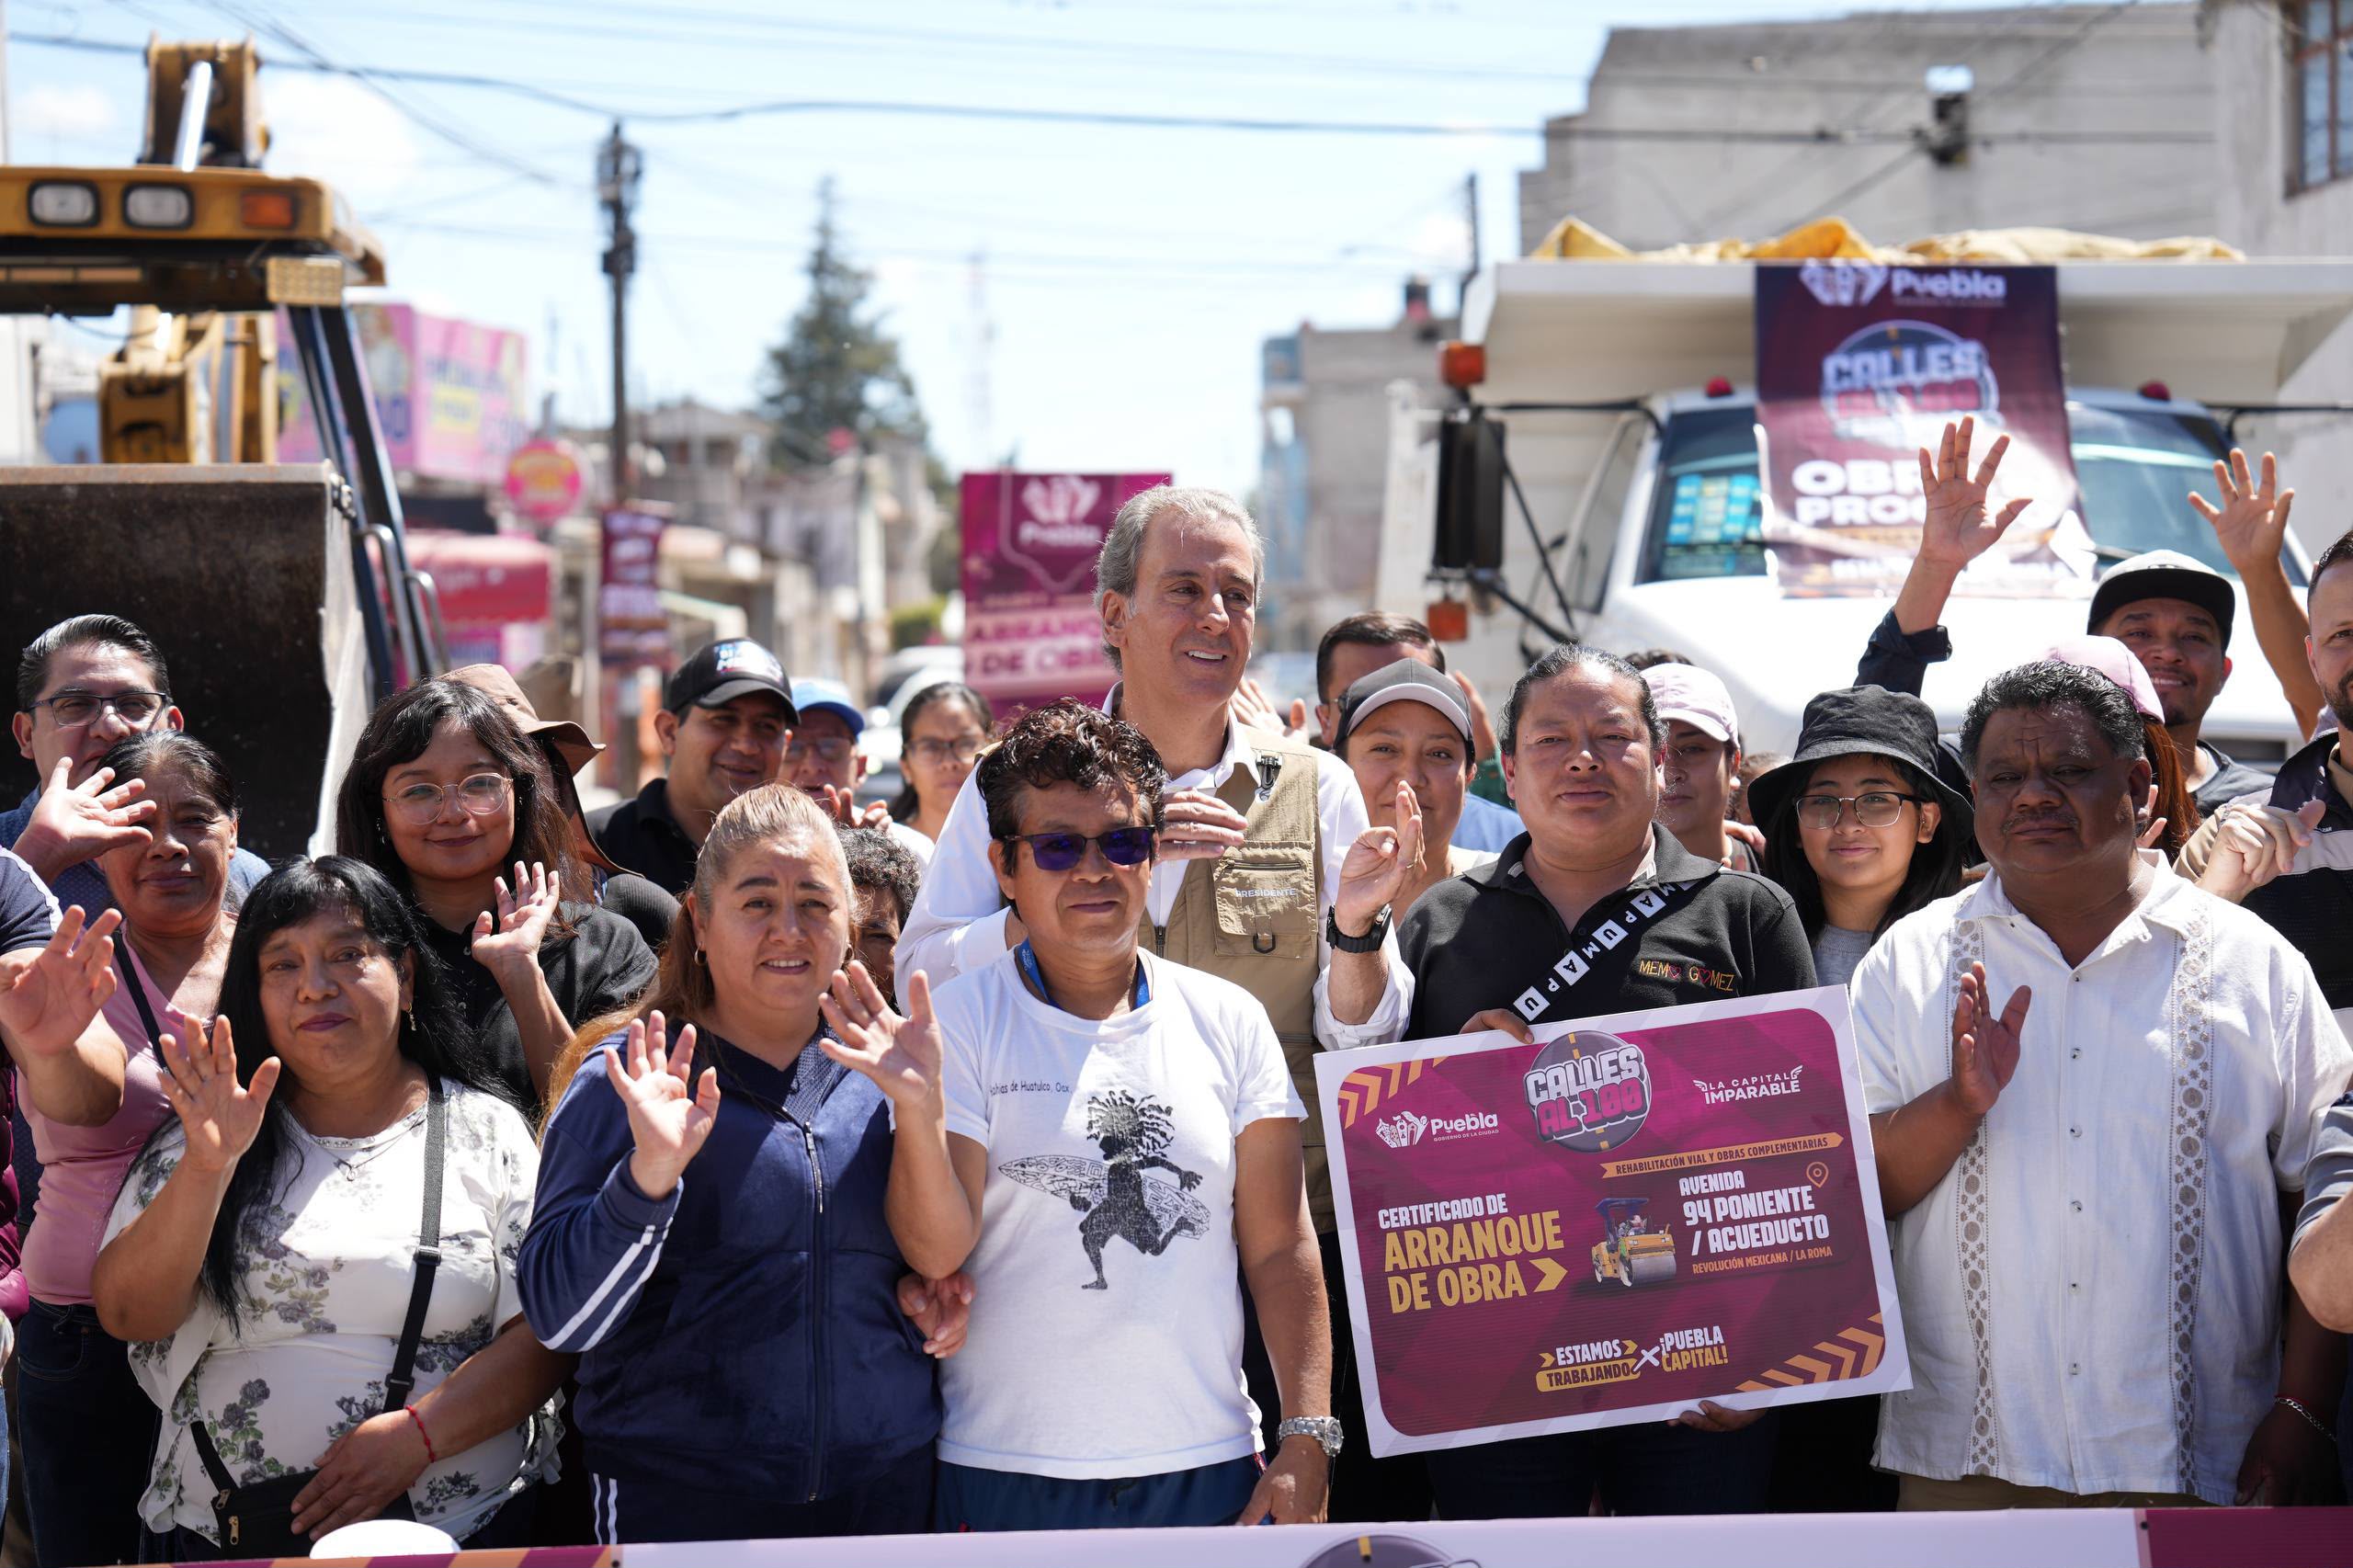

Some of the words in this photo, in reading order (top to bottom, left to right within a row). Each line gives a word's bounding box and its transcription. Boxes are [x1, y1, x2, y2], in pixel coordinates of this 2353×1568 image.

[1892, 267, 2007, 299] Puebla
[1822, 340, 1984, 392] CALLES
[1235, 888, 1297, 898] PRESIDENTE
[1010, 1079, 1018, 1092] de
[1525, 1045, 1642, 1107] CALLES
[1709, 1082, 1725, 1091] LA
[1731, 1073, 1790, 1088] CAPITAL
[1536, 1096, 1579, 1136] AL
[1578, 1077, 1643, 1125] 100
[1704, 1079, 1802, 1105] IMPARABLE
[1430, 1111, 1499, 1136] Puebla
[1433, 1133, 1462, 1142] GOBIERNO
[1478, 1129, 1500, 1137] CIUDAD
[1615, 1154, 1686, 1175] REHABILITACIÓN
[1687, 1153, 1708, 1165] VIAL
[1708, 1152, 1715, 1162] Y
[1716, 1148, 1745, 1161] OBRAS
[1747, 1137, 1828, 1157] COMPLEMENTARIAS
[1678, 1170, 1745, 1197] AVENIDA
[1378, 1196, 1485, 1230] CERTIFICADO
[1484, 1192, 1508, 1216] DE
[1683, 1199, 1712, 1226] 94
[1714, 1185, 1815, 1222] PONIENTE
[1384, 1210, 1565, 1273] ARRANQUE
[1707, 1213, 1830, 1255] ACUEDUCTO
[1691, 1256, 1745, 1275] REVOLUCIÓN
[1745, 1252, 1789, 1268] MEXICANA
[1795, 1249, 1807, 1261] LA
[1807, 1245, 1834, 1260] ROMA
[1387, 1271, 1432, 1314] DE
[1437, 1259, 1529, 1308] OBRA
[1555, 1338, 1623, 1367] ESTAMOS
[1659, 1325, 1725, 1357] ¡PUEBLA
[1661, 1345, 1729, 1373] CAPITAL!
[1546, 1362, 1631, 1388] TRABAJANDO
